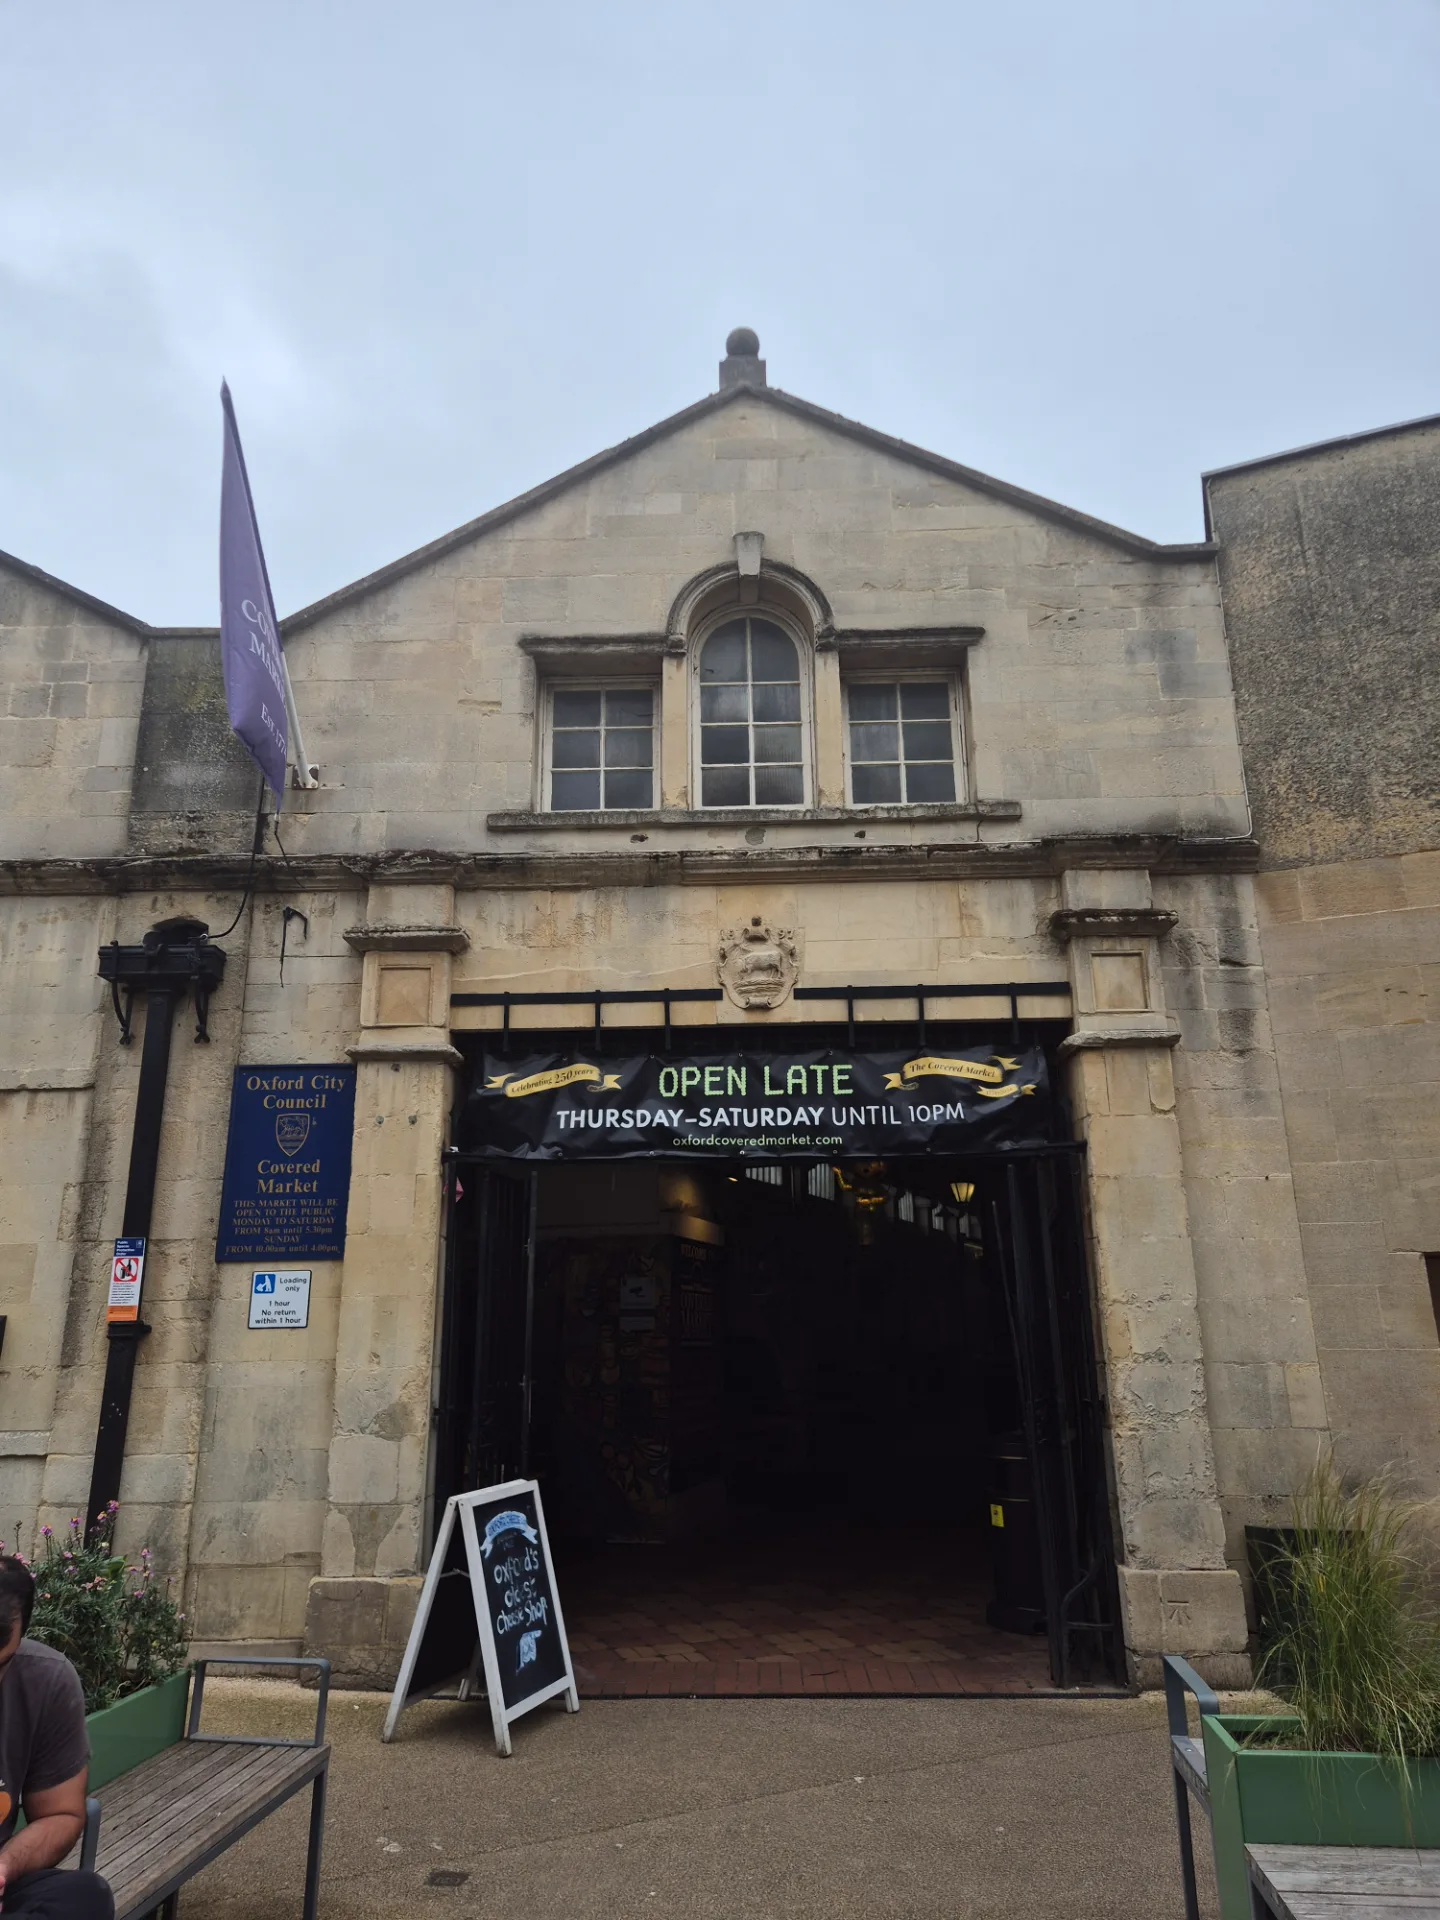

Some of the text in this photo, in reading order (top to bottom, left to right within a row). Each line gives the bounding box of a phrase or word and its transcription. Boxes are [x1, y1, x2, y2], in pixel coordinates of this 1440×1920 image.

[909, 1061, 996, 1078] The Covered Market
[246, 1074, 346, 1092] Oxford City
[511, 1069, 595, 1093] Celebrating 250 years
[659, 1064, 854, 1098] OPEN LATE
[263, 1094, 327, 1109] Council
[831, 1105, 902, 1126] UNTIL
[908, 1102, 965, 1123] 10PM
[672, 1133, 843, 1147] oxfordcoveredmarket.com
[257, 1159, 321, 1174] Covered
[256, 1179, 318, 1194] Market
[233, 1200, 256, 1208] THIS
[258, 1199, 297, 1207] MARKET
[236, 1207, 334, 1217] OPEN TO THE PUBLIC
[232, 1216, 336, 1226] MONDAY TO SATURDAY
[234, 1227, 261, 1235] FROM
[283, 1226, 302, 1234] until
[263, 1235, 301, 1243] SUNDAY
[225, 1245, 253, 1254] FROM
[289, 1244, 308, 1252] until
[279, 1277, 307, 1285] Loading
[494, 1547, 539, 1585] oxfod's
